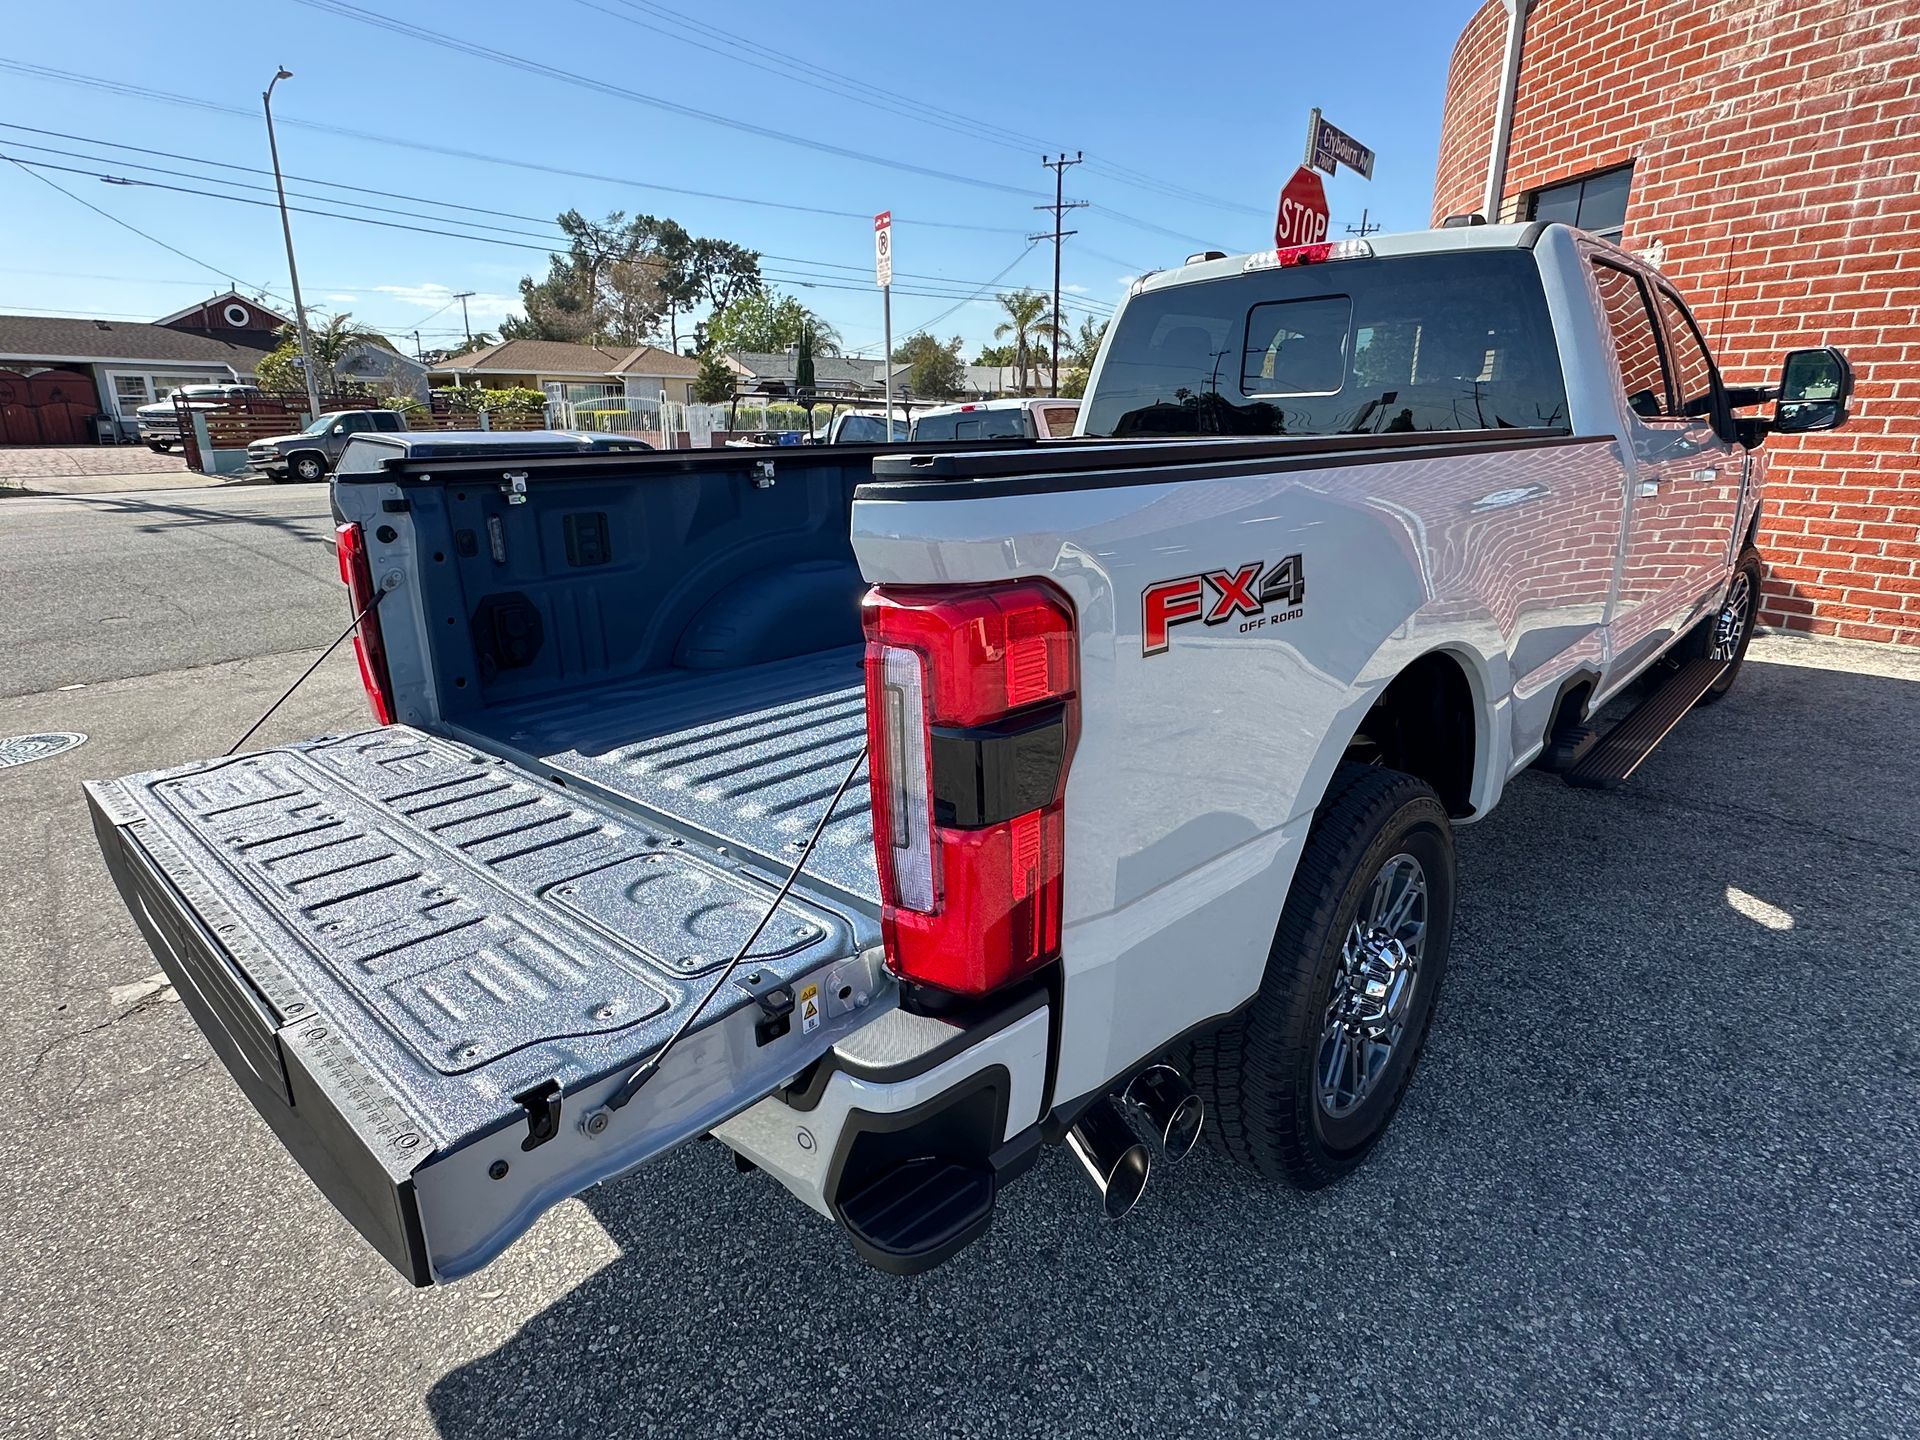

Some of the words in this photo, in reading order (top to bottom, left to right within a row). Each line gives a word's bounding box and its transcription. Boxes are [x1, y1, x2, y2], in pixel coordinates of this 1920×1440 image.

[1323, 128, 1358, 162] Clybourn
[1280, 198, 1326, 244] STOP
[1141, 553, 1304, 658] FX4
[1239, 618, 1266, 633] OFF
[1270, 608, 1303, 625] ROAD
